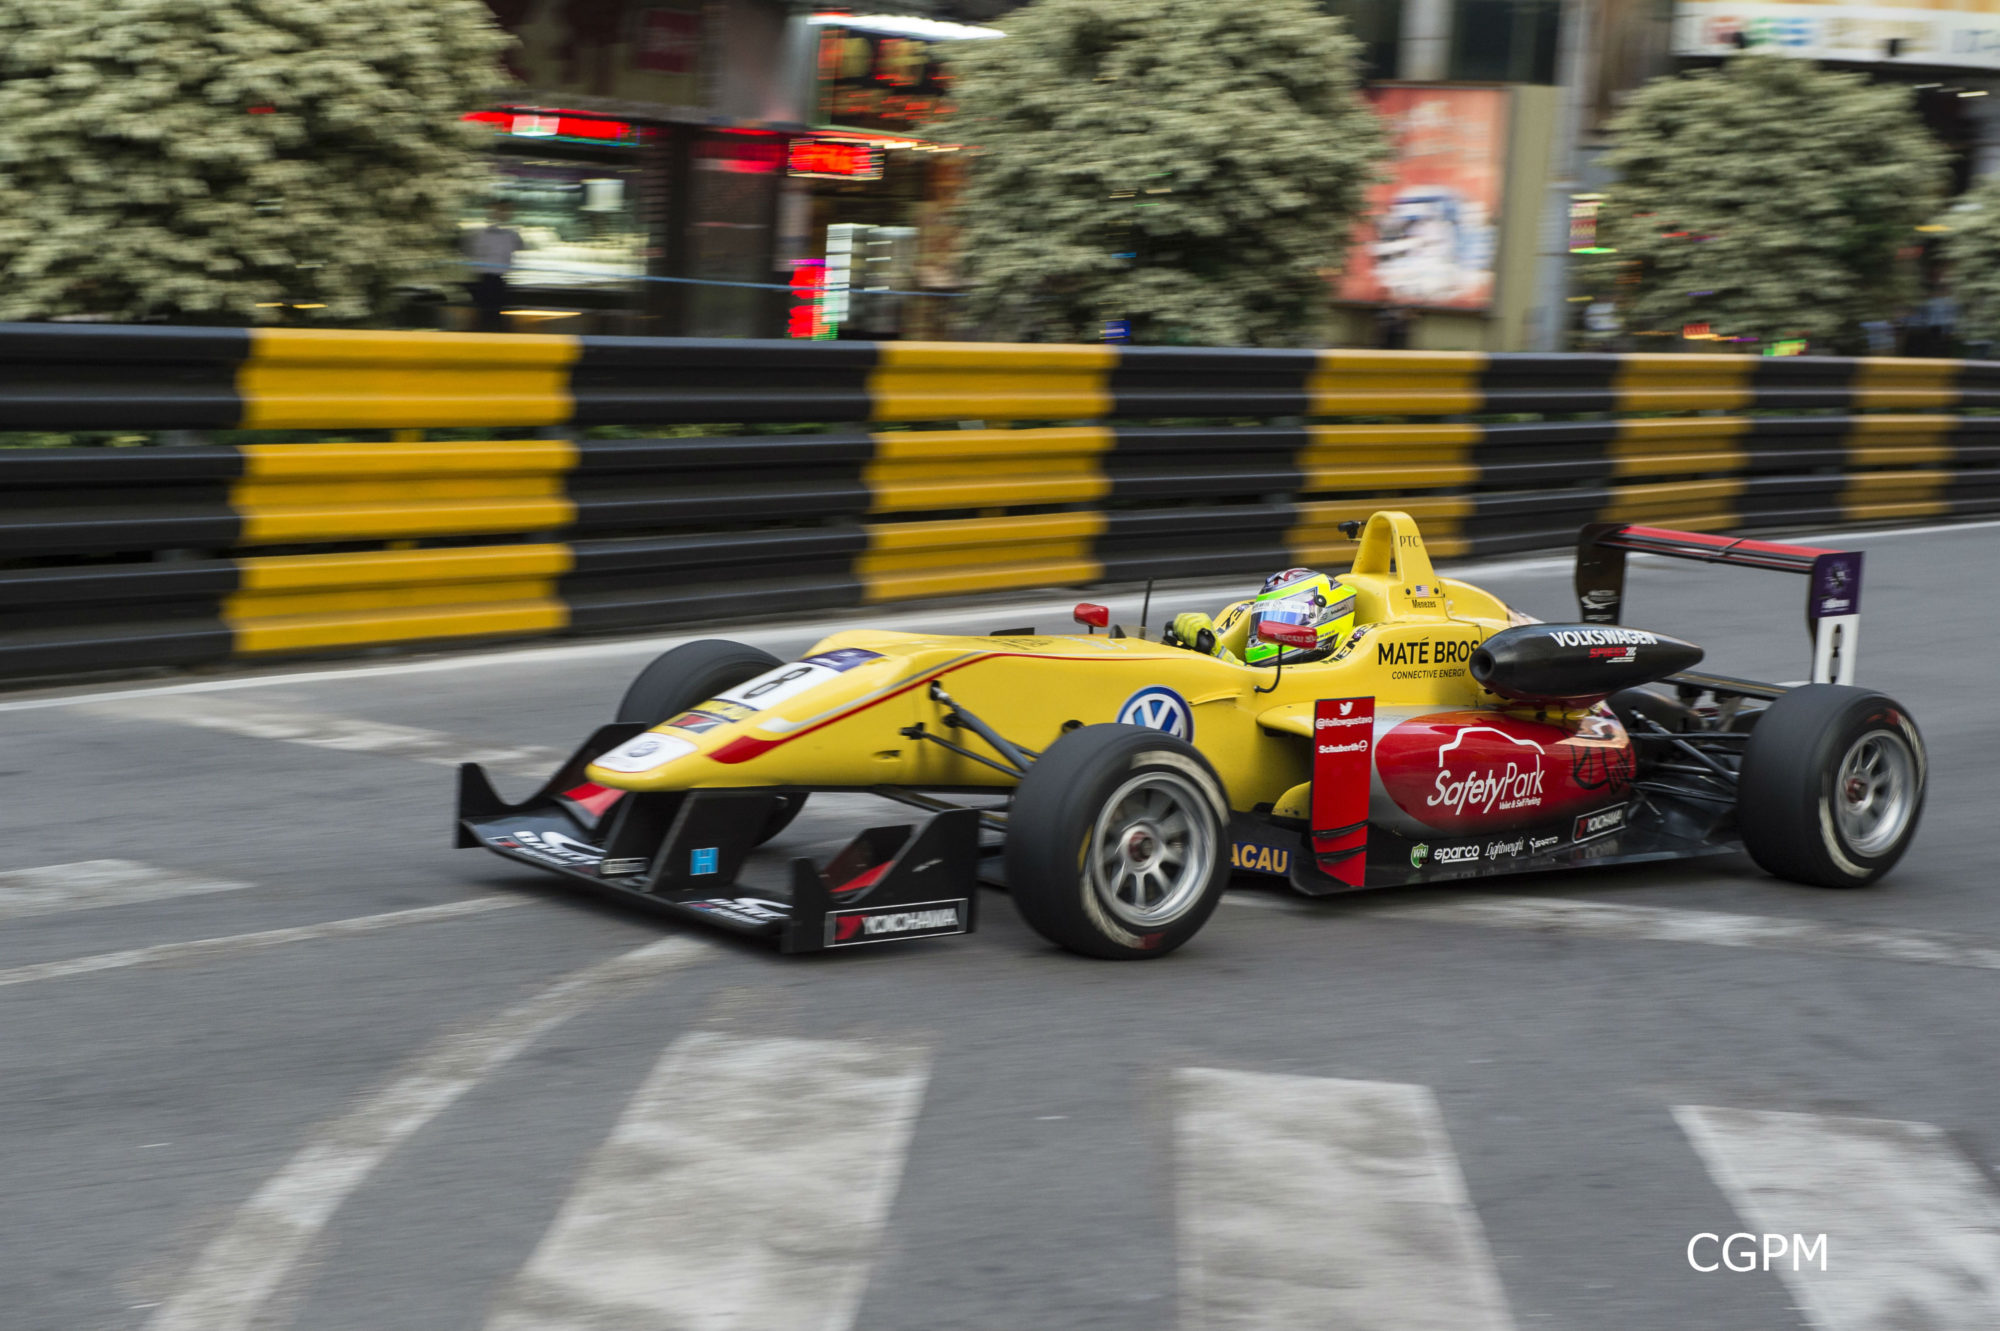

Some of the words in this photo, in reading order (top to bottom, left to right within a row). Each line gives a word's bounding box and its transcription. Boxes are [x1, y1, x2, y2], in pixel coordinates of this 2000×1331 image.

[1400, 535, 1420, 548] PTC
[1549, 630, 1658, 647] VOLKSWAGEN
[1378, 636, 1429, 665] MATÉ
[742, 665, 814, 700] 8
[1391, 670, 1438, 680] CONNECTIVE
[1438, 668, 1466, 678] ENERGY
[1230, 843, 1288, 873] ACAU
[1434, 844, 1480, 864] sparco
